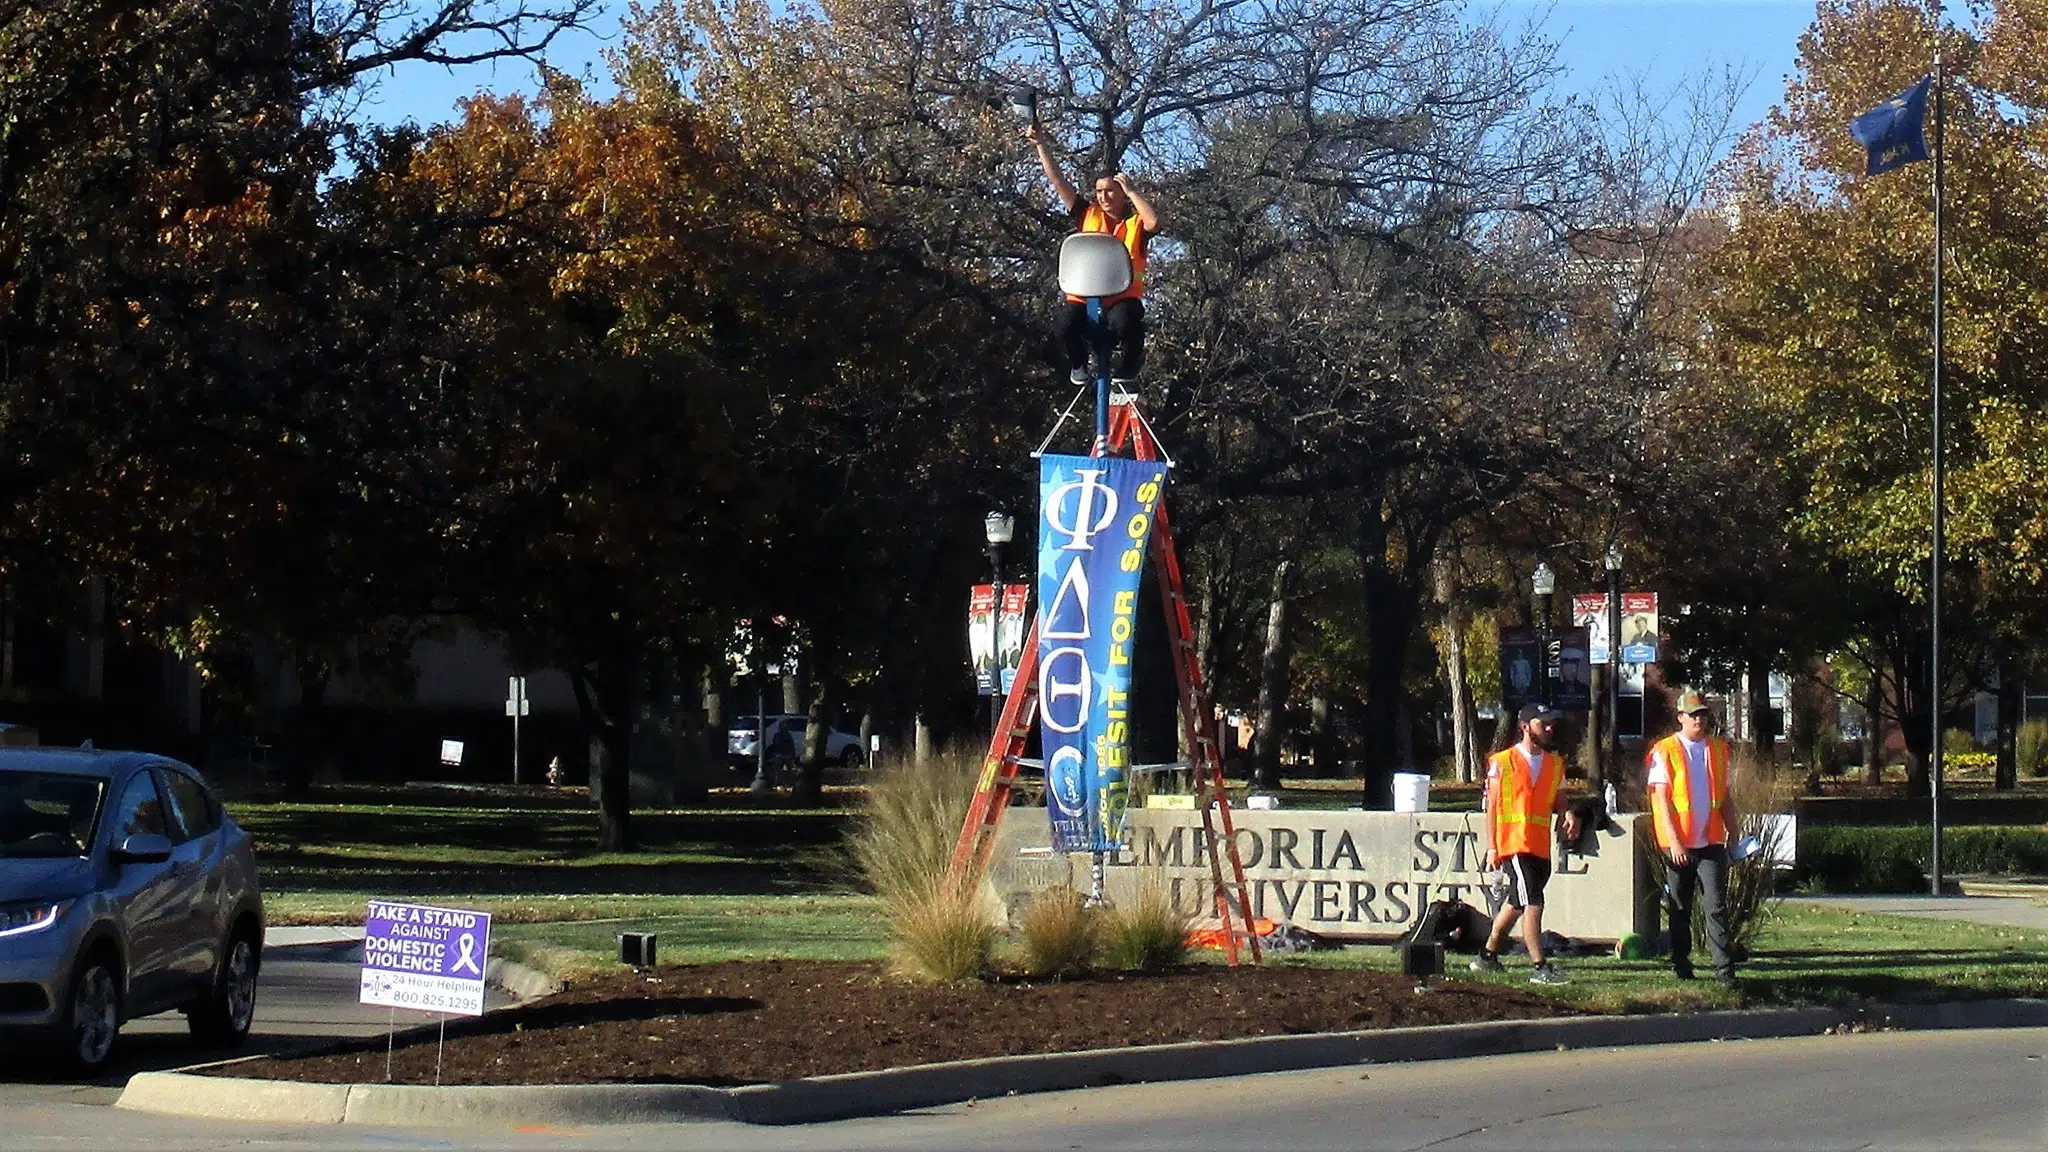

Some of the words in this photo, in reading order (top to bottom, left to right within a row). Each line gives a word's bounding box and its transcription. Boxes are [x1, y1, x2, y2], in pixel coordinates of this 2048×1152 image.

[1120, 473, 1163, 573] S.O.S.
[1109, 590, 1135, 667] FOR
[1107, 688, 1128, 839] OLESIT
[1413, 830, 1589, 875] STE
[368, 904, 407, 921] TAKE
[409, 909, 420, 923] A
[424, 910, 476, 929] STAND
[390, 923, 450, 941] AGAINST
[365, 936, 445, 958] DOMESTIC
[365, 951, 442, 973] VIOLENCE
[392, 974, 405, 985] 24
[408, 977, 434, 988] Hour
[437, 980, 482, 994] Helpline
[393, 991, 478, 1011] 800.825.1295
